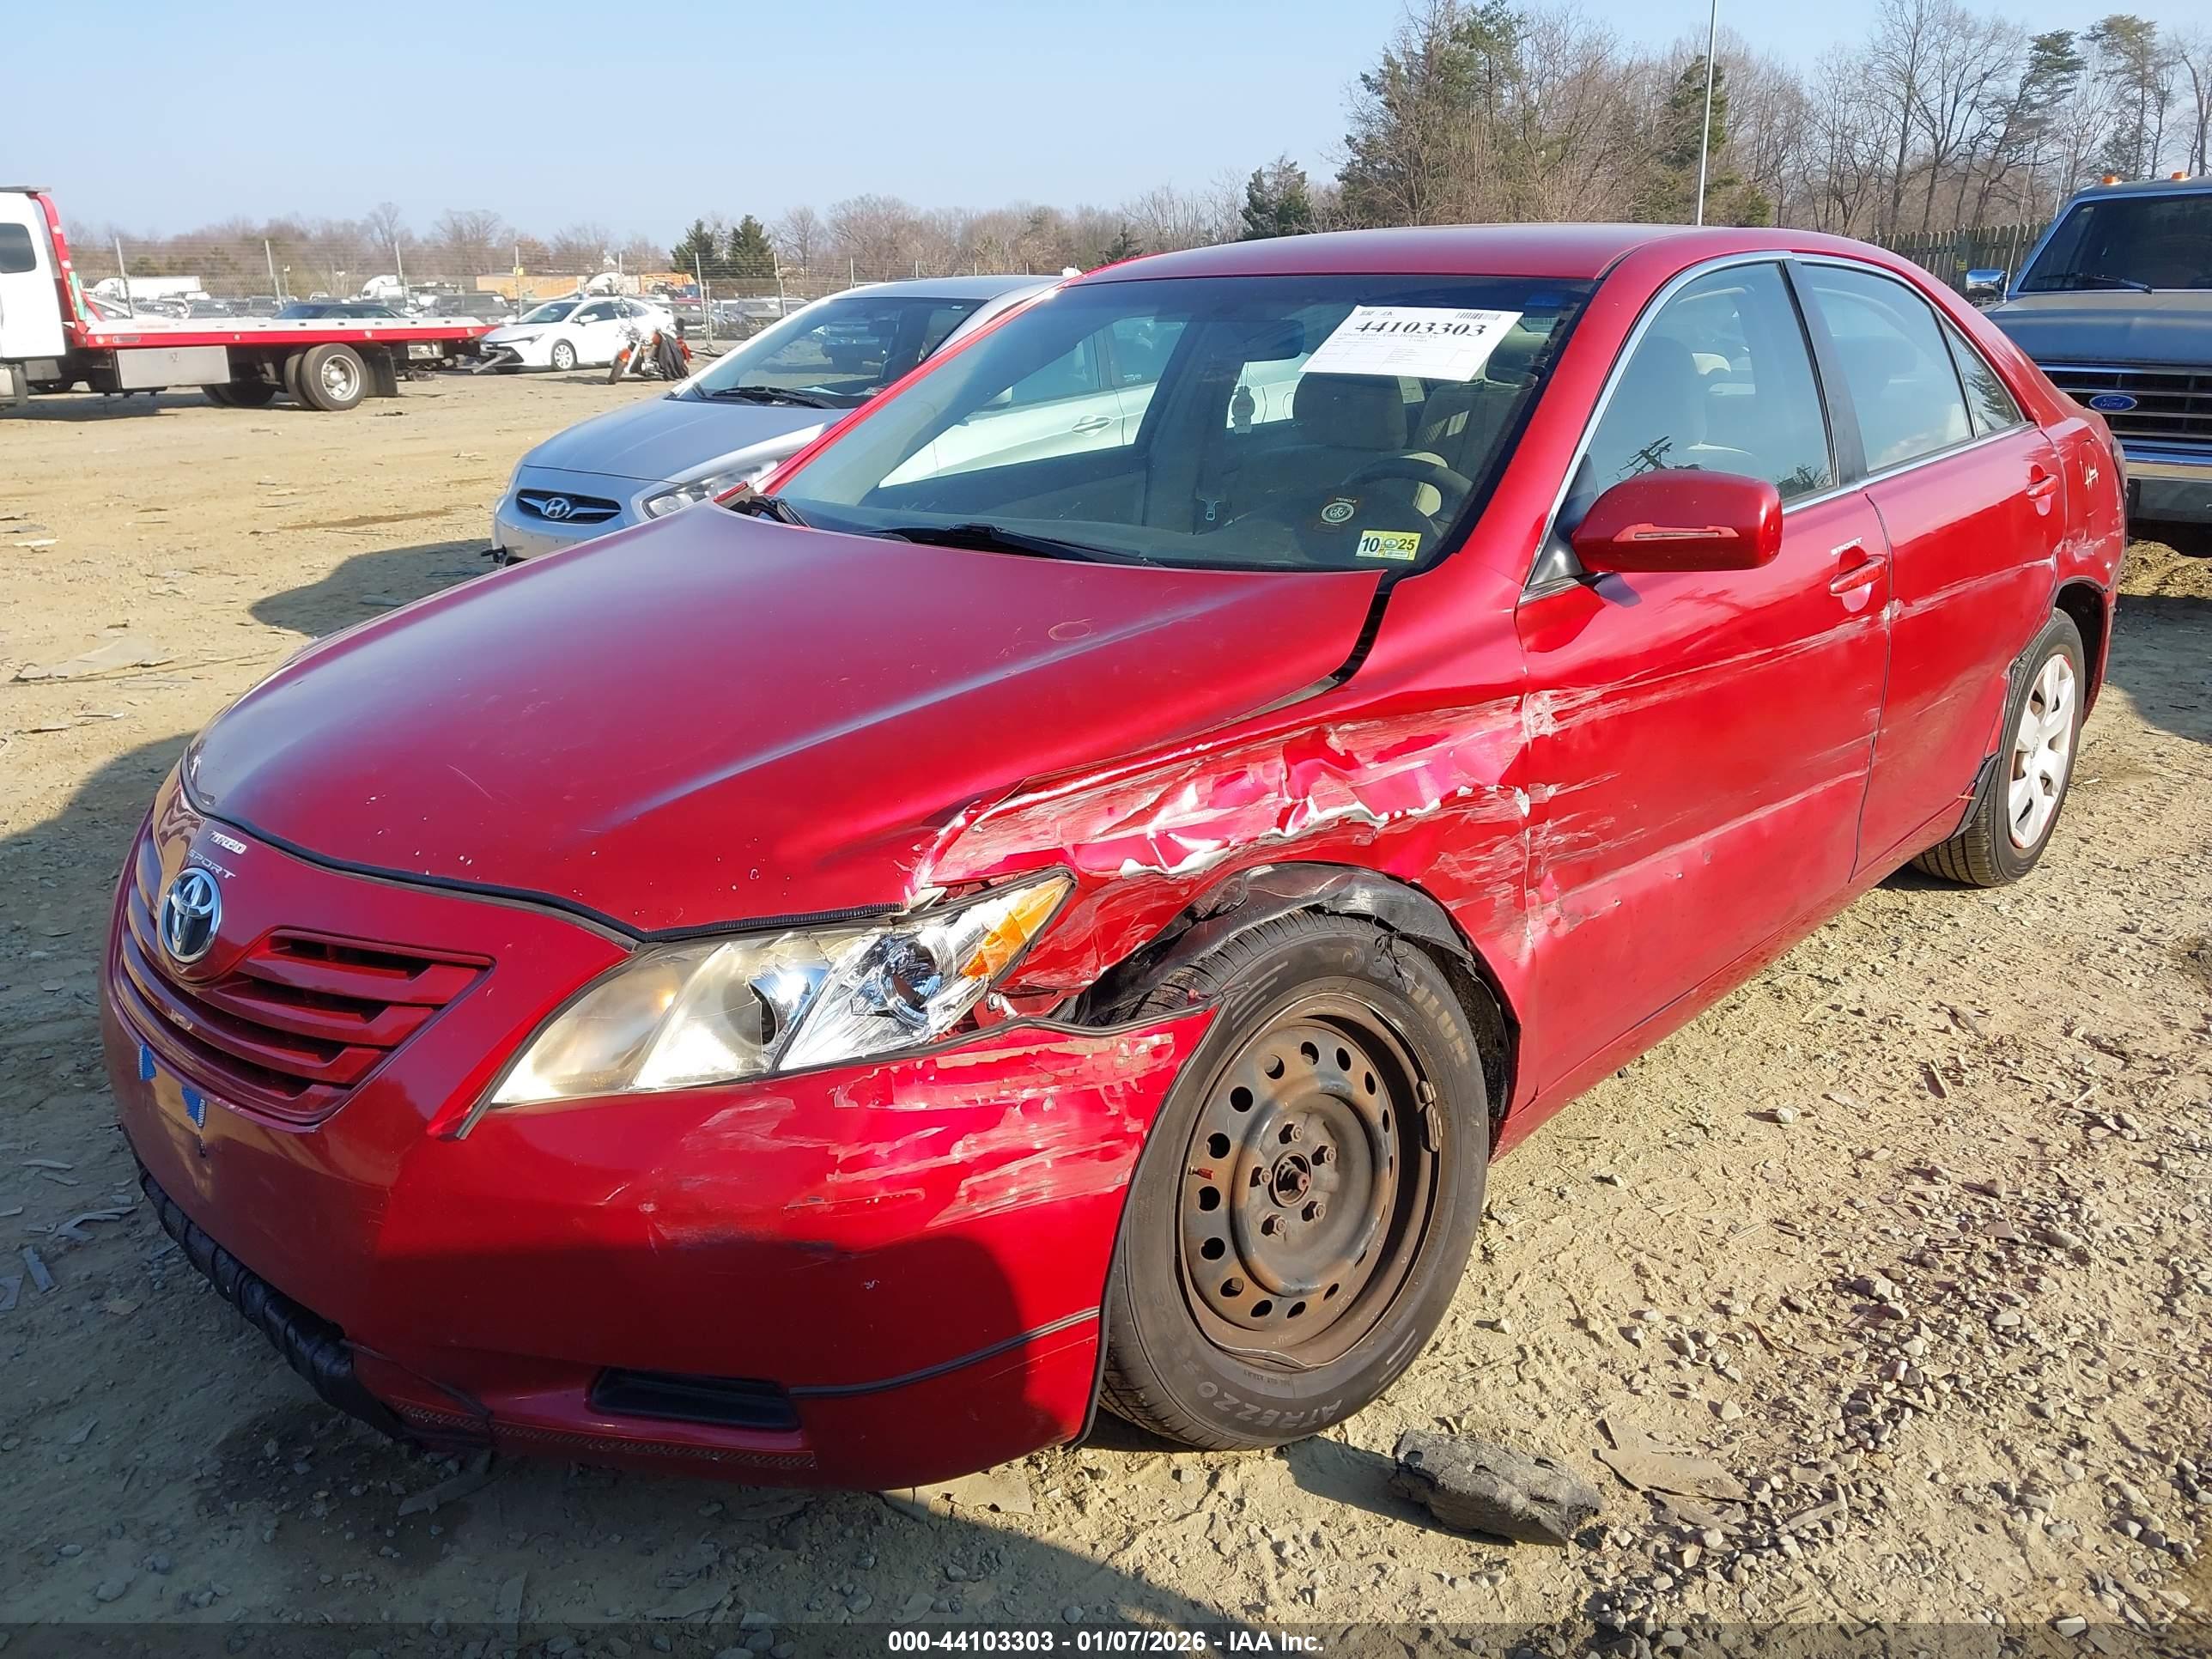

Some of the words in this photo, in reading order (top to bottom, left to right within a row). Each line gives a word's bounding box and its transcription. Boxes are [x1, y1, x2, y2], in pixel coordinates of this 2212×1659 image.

[1355, 320, 1487, 337] 44103303
[1362, 537, 1380, 552] 10
[1397, 538, 1415, 550] 25
[187, 848, 237, 879] SPORT
[1196, 1381, 1344, 1430] ATREZZO
